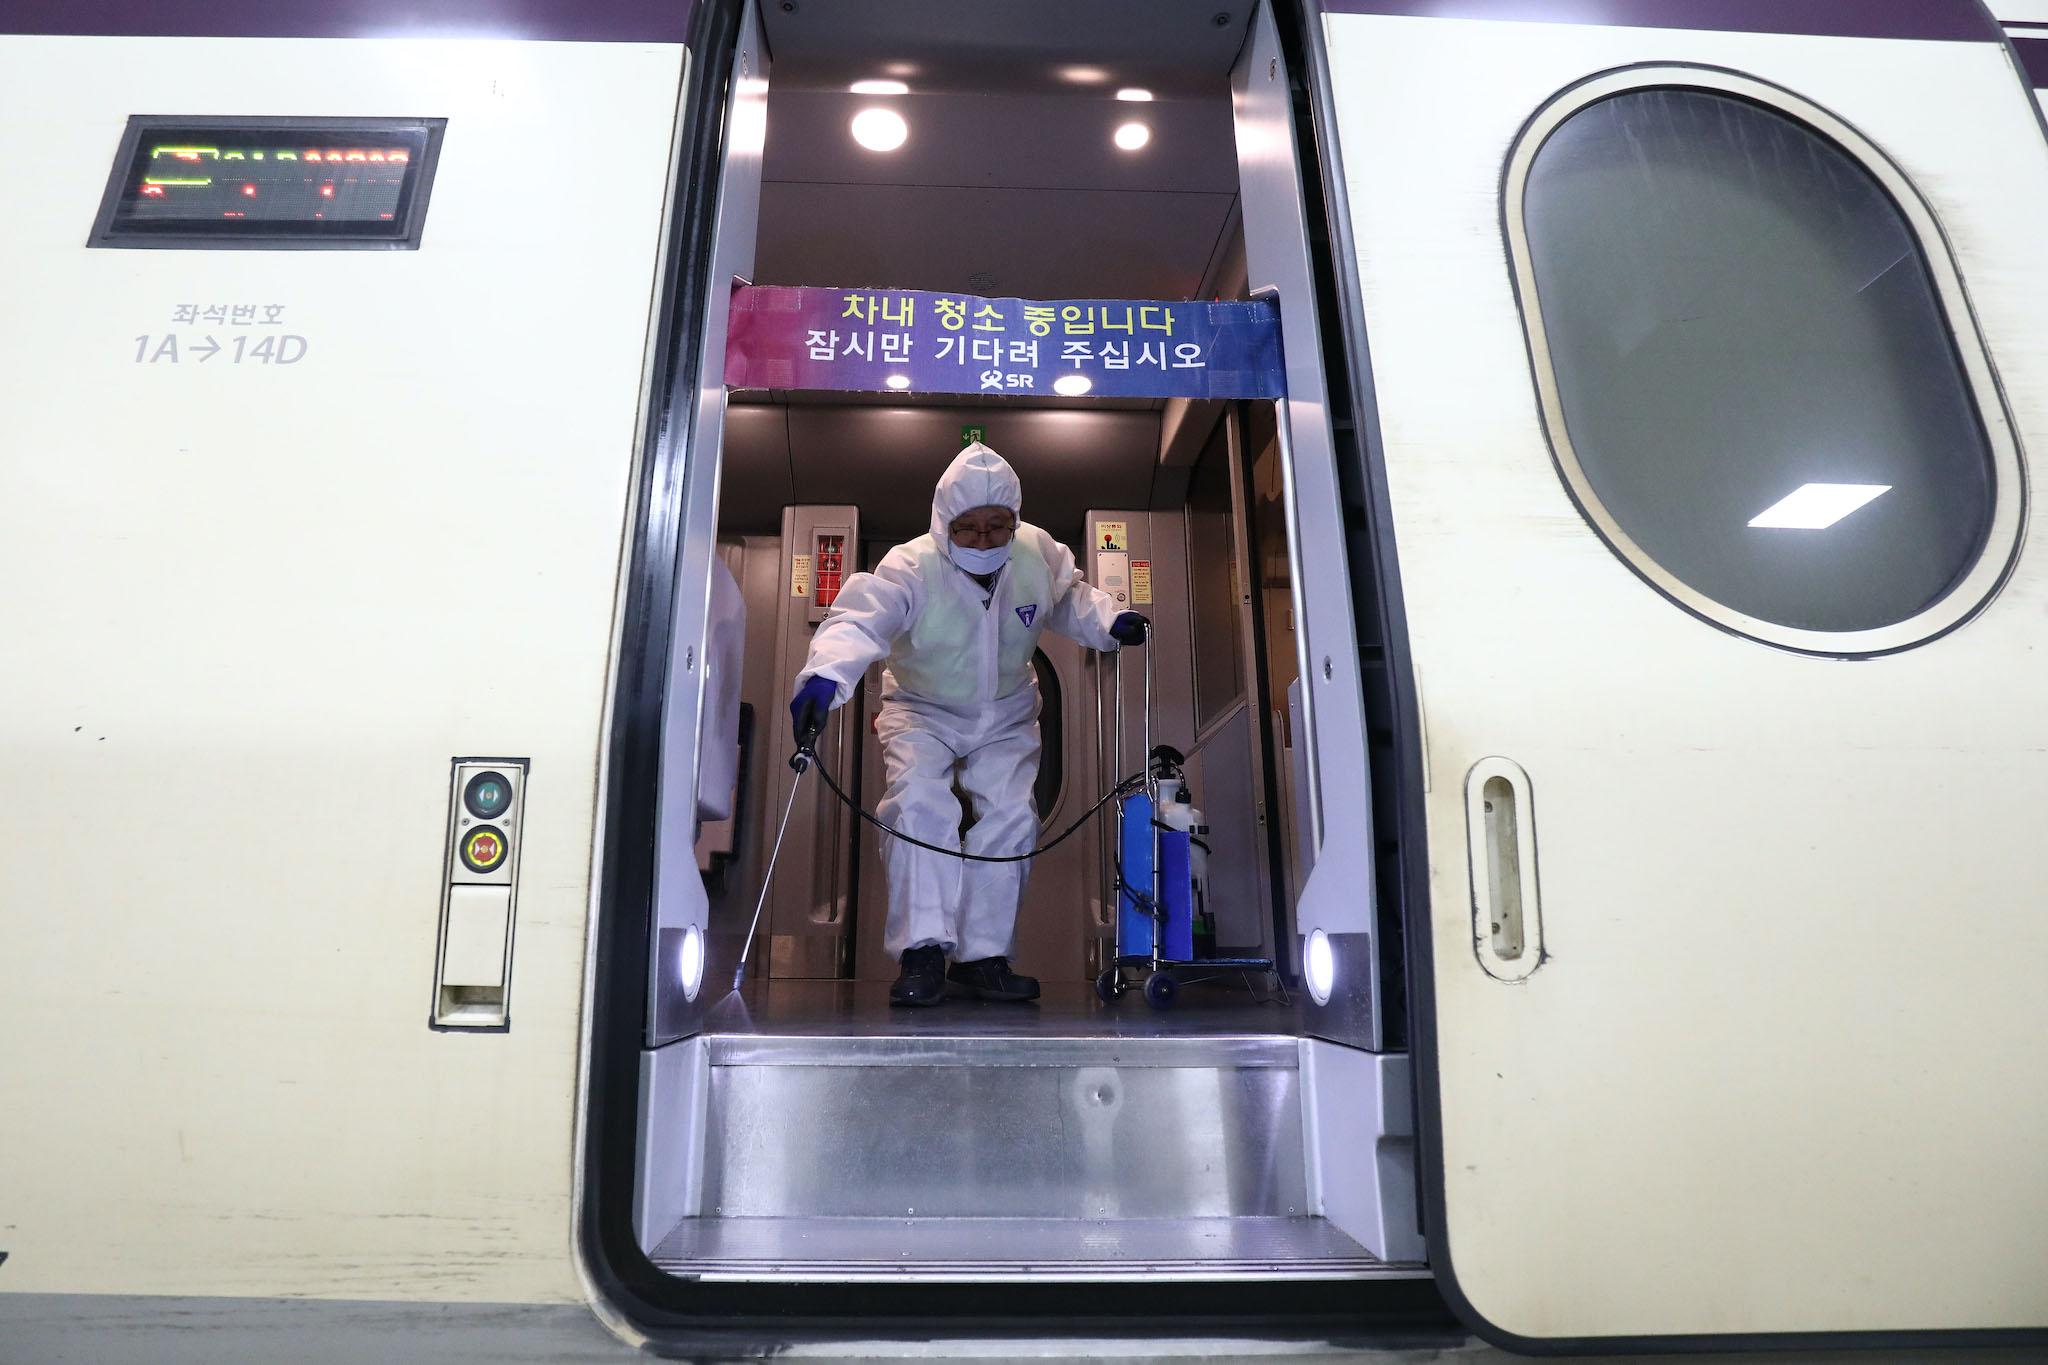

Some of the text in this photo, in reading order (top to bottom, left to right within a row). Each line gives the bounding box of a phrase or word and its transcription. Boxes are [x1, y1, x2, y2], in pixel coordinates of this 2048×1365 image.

[172, 304, 285, 326] 좌석번호
[841, 294, 1175, 337] 차내 청소 중입니다
[805, 329, 1206, 370] 잠시만 기다려 주십시오
[1006, 374, 1034, 388] SR
